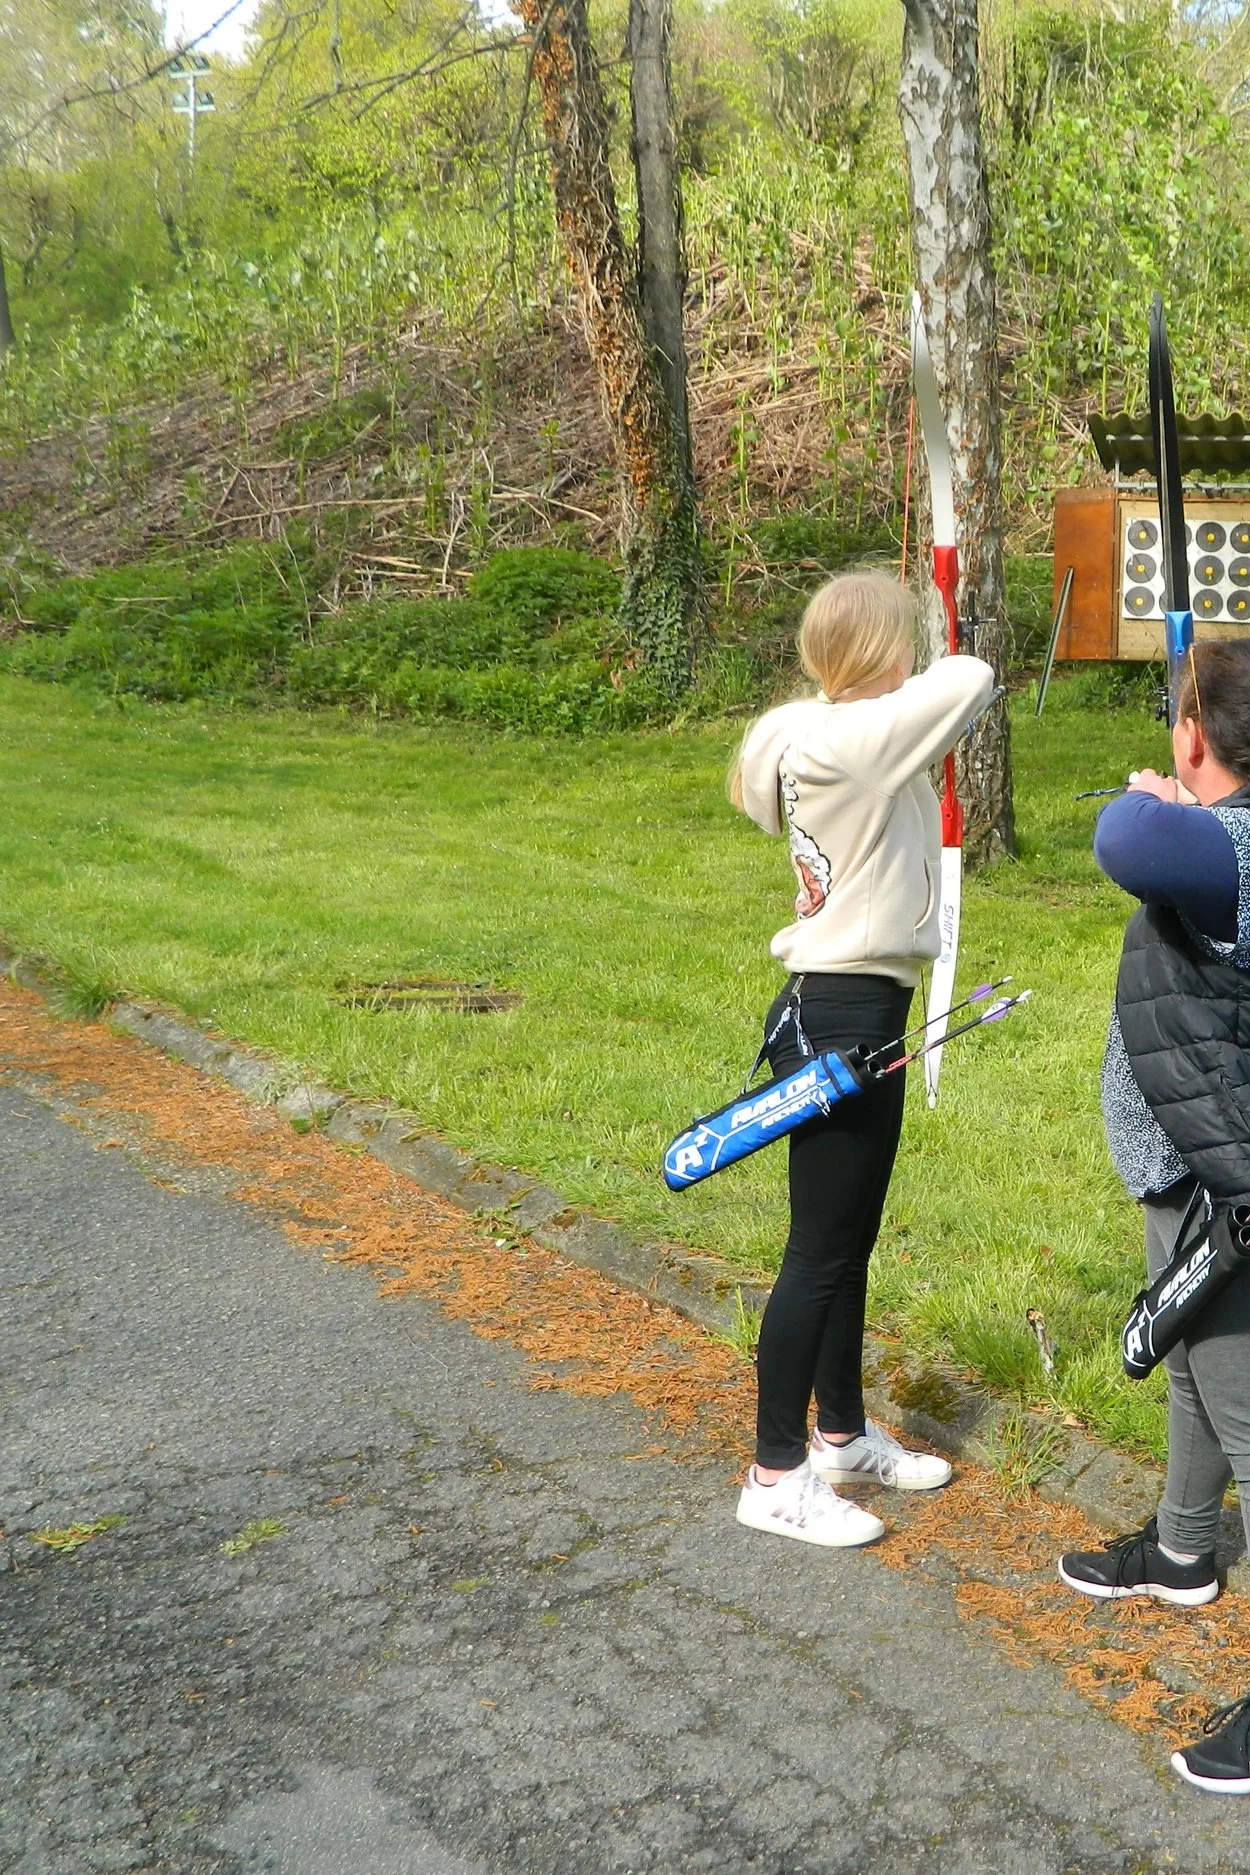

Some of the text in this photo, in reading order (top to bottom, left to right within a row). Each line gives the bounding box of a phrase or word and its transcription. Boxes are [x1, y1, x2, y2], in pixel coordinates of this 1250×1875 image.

[942, 904, 954, 949] SHIFT
[731, 1069, 817, 1129] AVALON
[1157, 1236, 1210, 1309] AVALON
